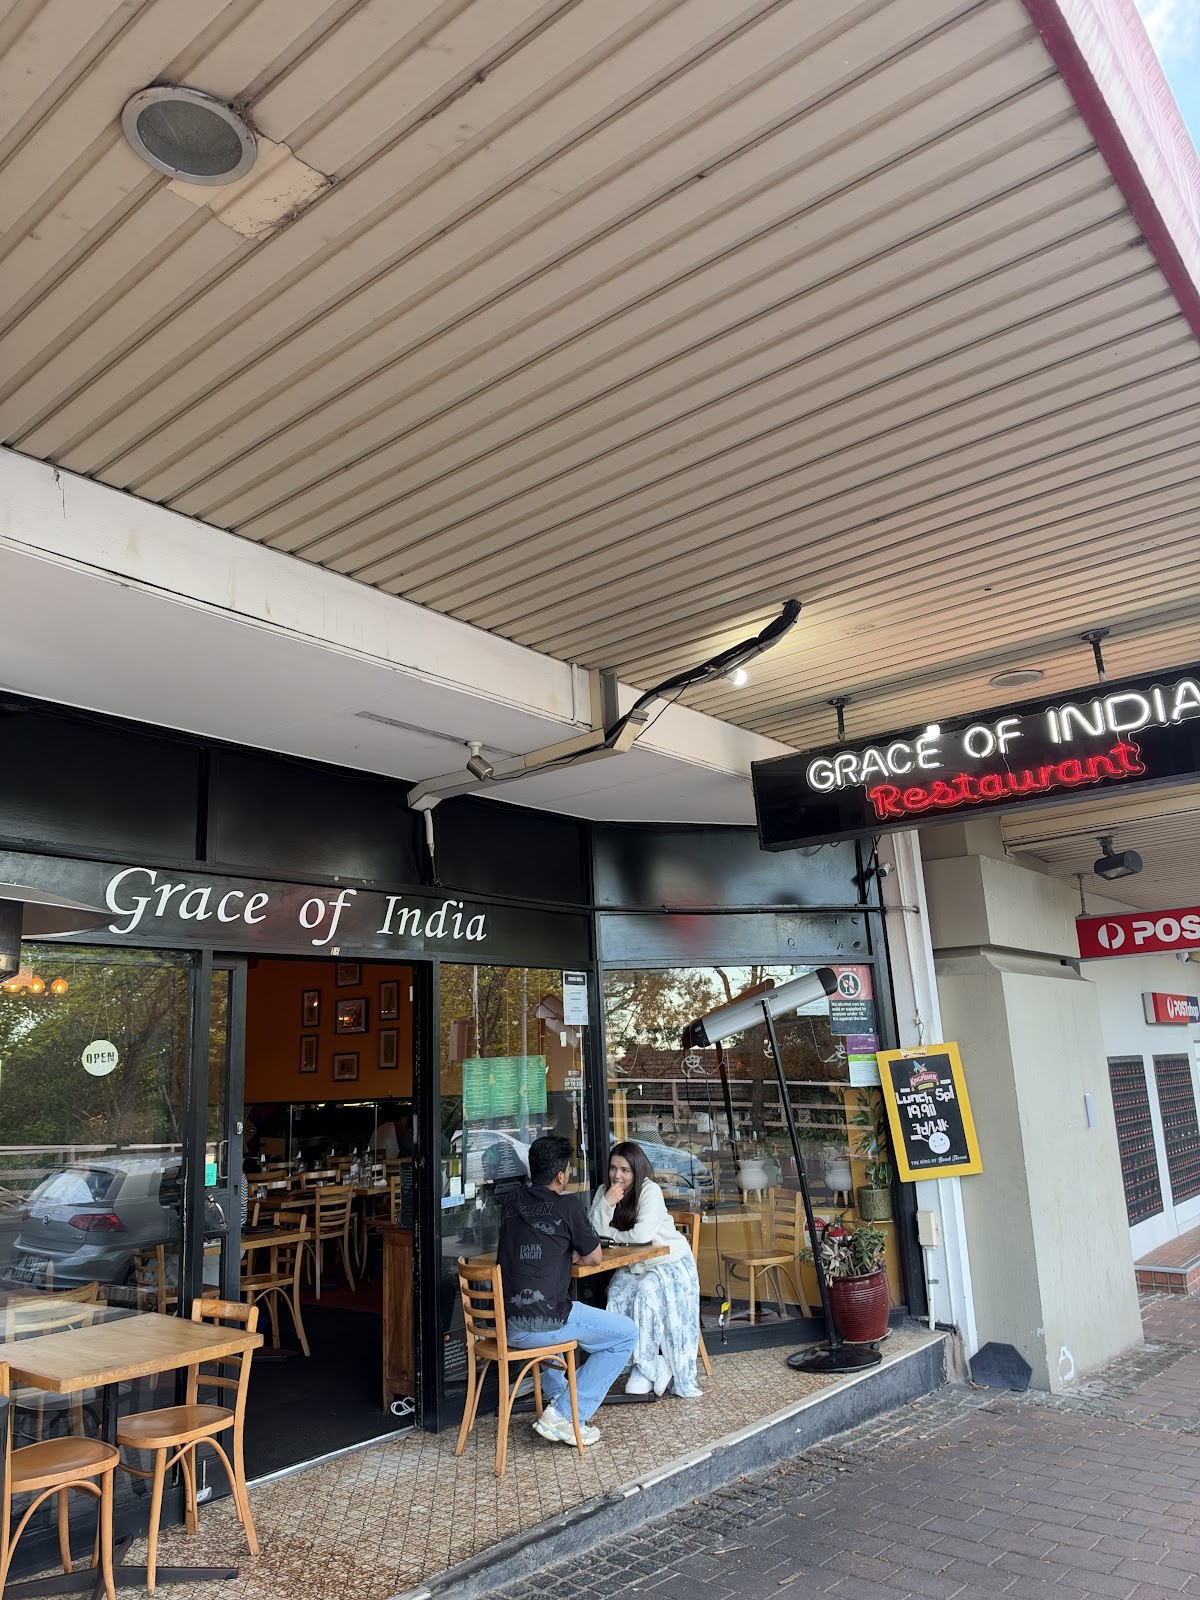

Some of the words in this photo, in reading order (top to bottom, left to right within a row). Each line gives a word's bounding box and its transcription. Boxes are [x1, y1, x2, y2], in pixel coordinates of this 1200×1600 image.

[808, 741, 942, 790] GRACE
[963, 718, 1023, 759] OF
[1048, 682, 1200, 743] INDIA
[869, 741, 1142, 819] Restaurant
[104, 866, 270, 934] Grace
[298, 888, 358, 946] of
[376, 895, 488, 942] India
[86, 1052, 115, 1064] OPEN
[895, 1090, 933, 1105] Lunch
[520, 1243, 542, 1252] DARK
[520, 1251, 542, 1260] KNIGHT
